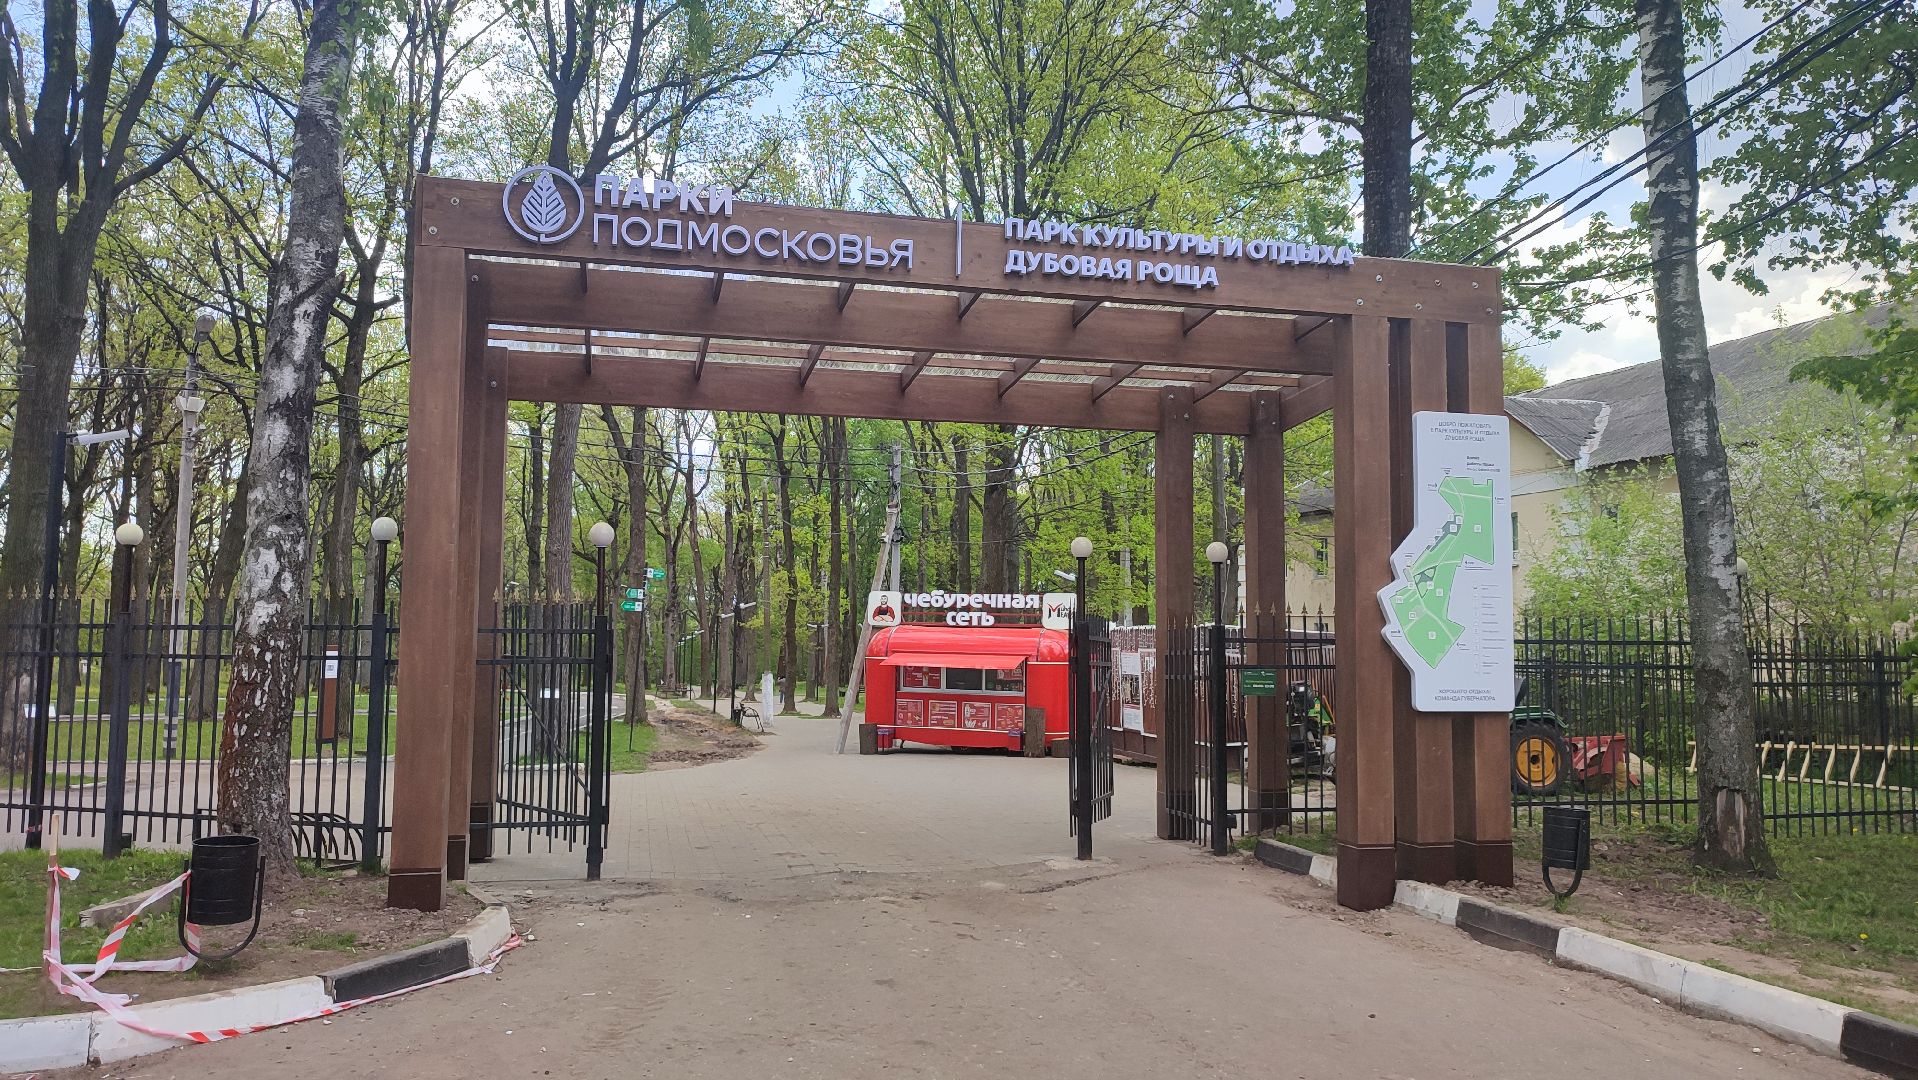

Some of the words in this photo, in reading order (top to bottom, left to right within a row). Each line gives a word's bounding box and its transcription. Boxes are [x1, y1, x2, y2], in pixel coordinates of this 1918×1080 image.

[594, 174, 734, 216] ПАРКИ
[592, 212, 914, 270] ПОДМОСКОВЬЯ
[1004, 217, 1080, 246] ПАРК
[1082, 224, 1219, 256] КУЛЬТУРЫ
[1222, 237, 1243, 258] И
[1246, 239, 1355, 266] ОТДЫХА
[1004, 250, 1132, 281] ДУБОВАЯ
[1136, 260, 1219, 289] РОЩА
[904, 590, 1040, 609] чебуречная
[946, 611, 995, 627] сеть
